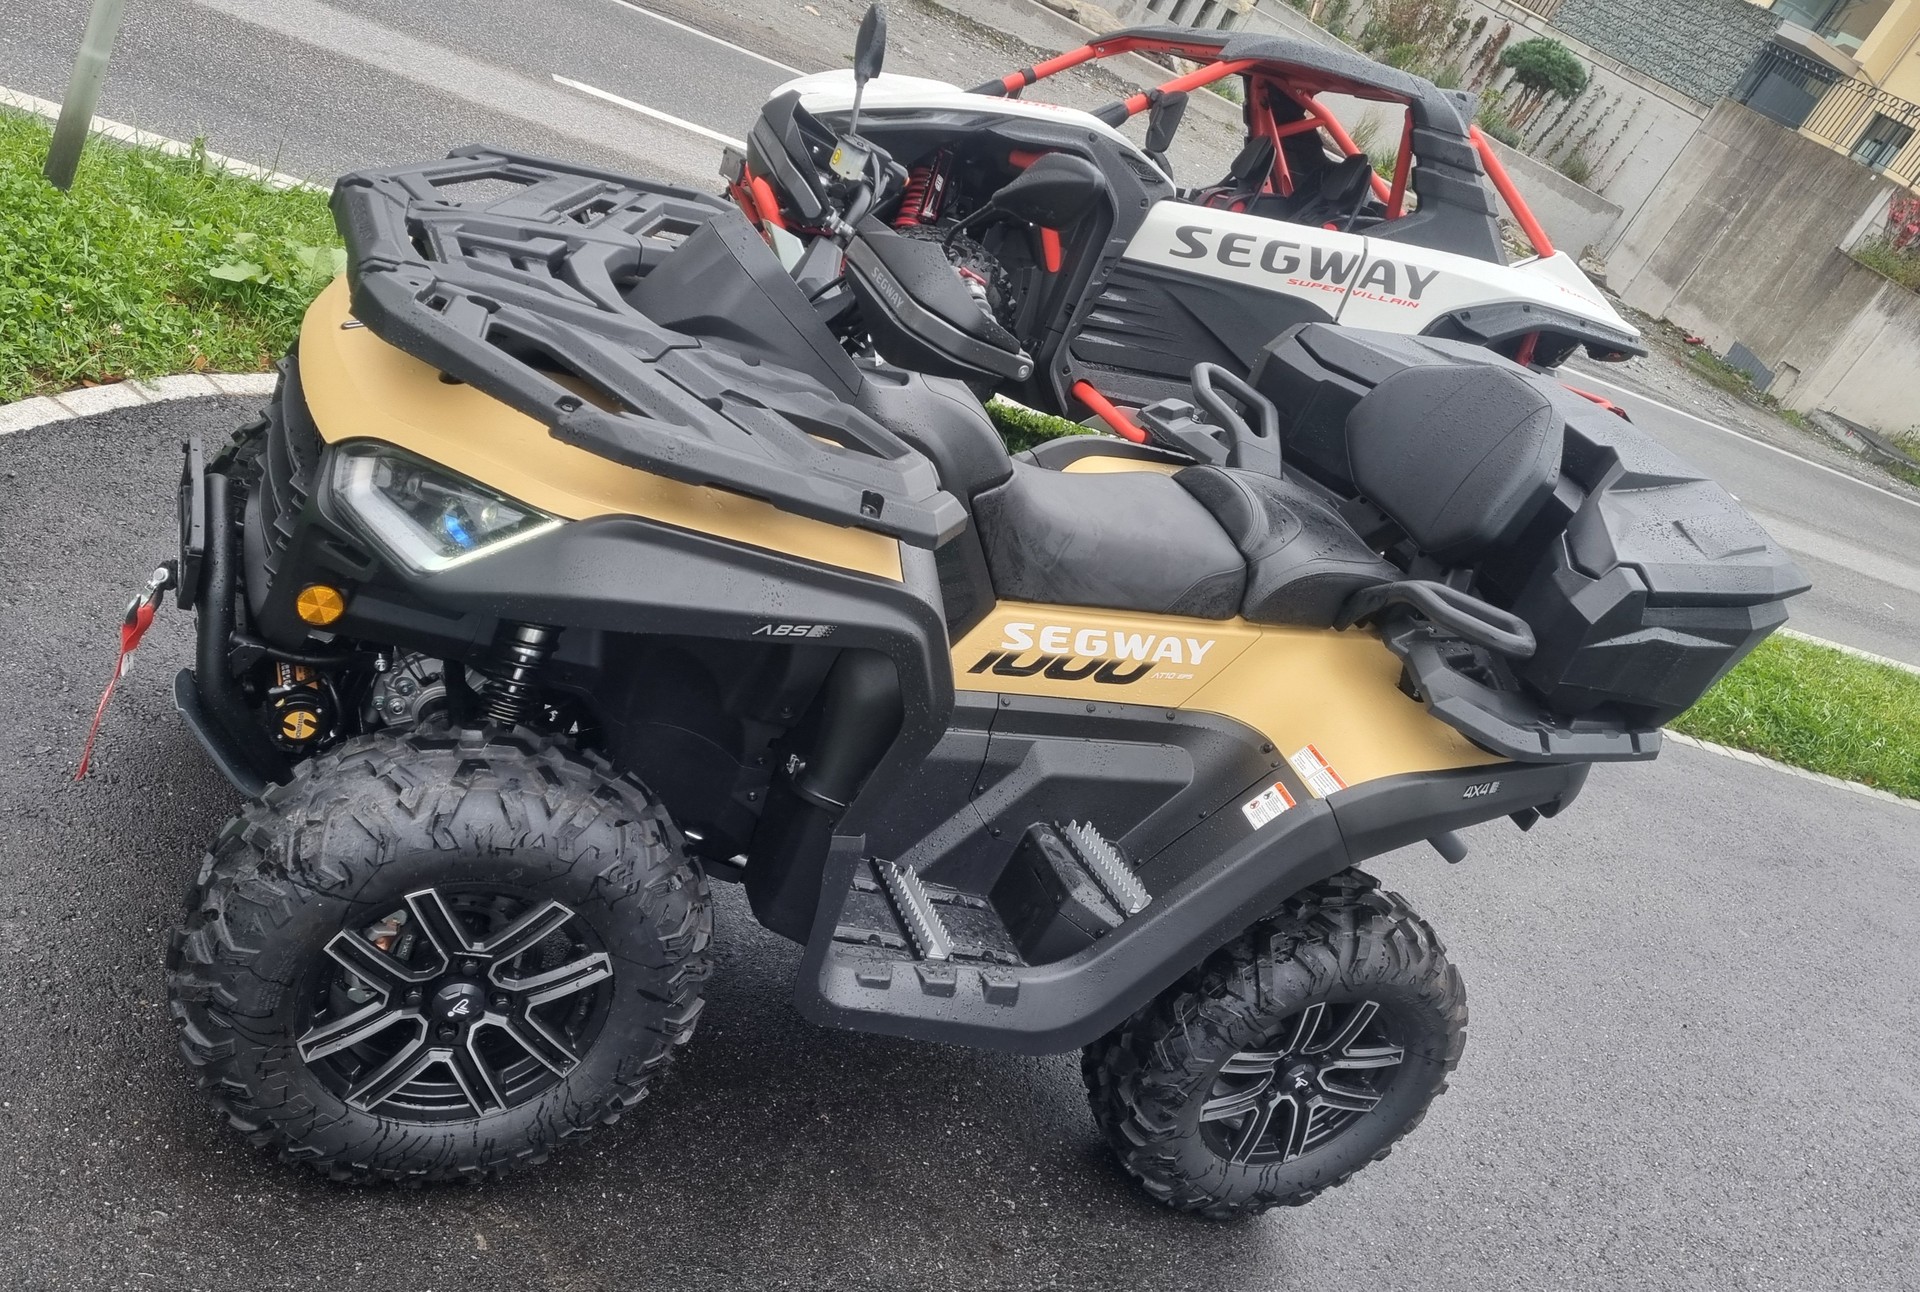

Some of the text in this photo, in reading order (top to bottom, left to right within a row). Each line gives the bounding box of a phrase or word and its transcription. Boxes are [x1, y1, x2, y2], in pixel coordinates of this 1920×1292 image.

[1168, 225, 1440, 300] SEGWAY
[871, 266, 904, 308] SEGWAY
[1286, 278, 1420, 309] SUPER VILLAIN
[752, 624, 812, 637] ABS
[1000, 622, 1216, 665] SEGWAY
